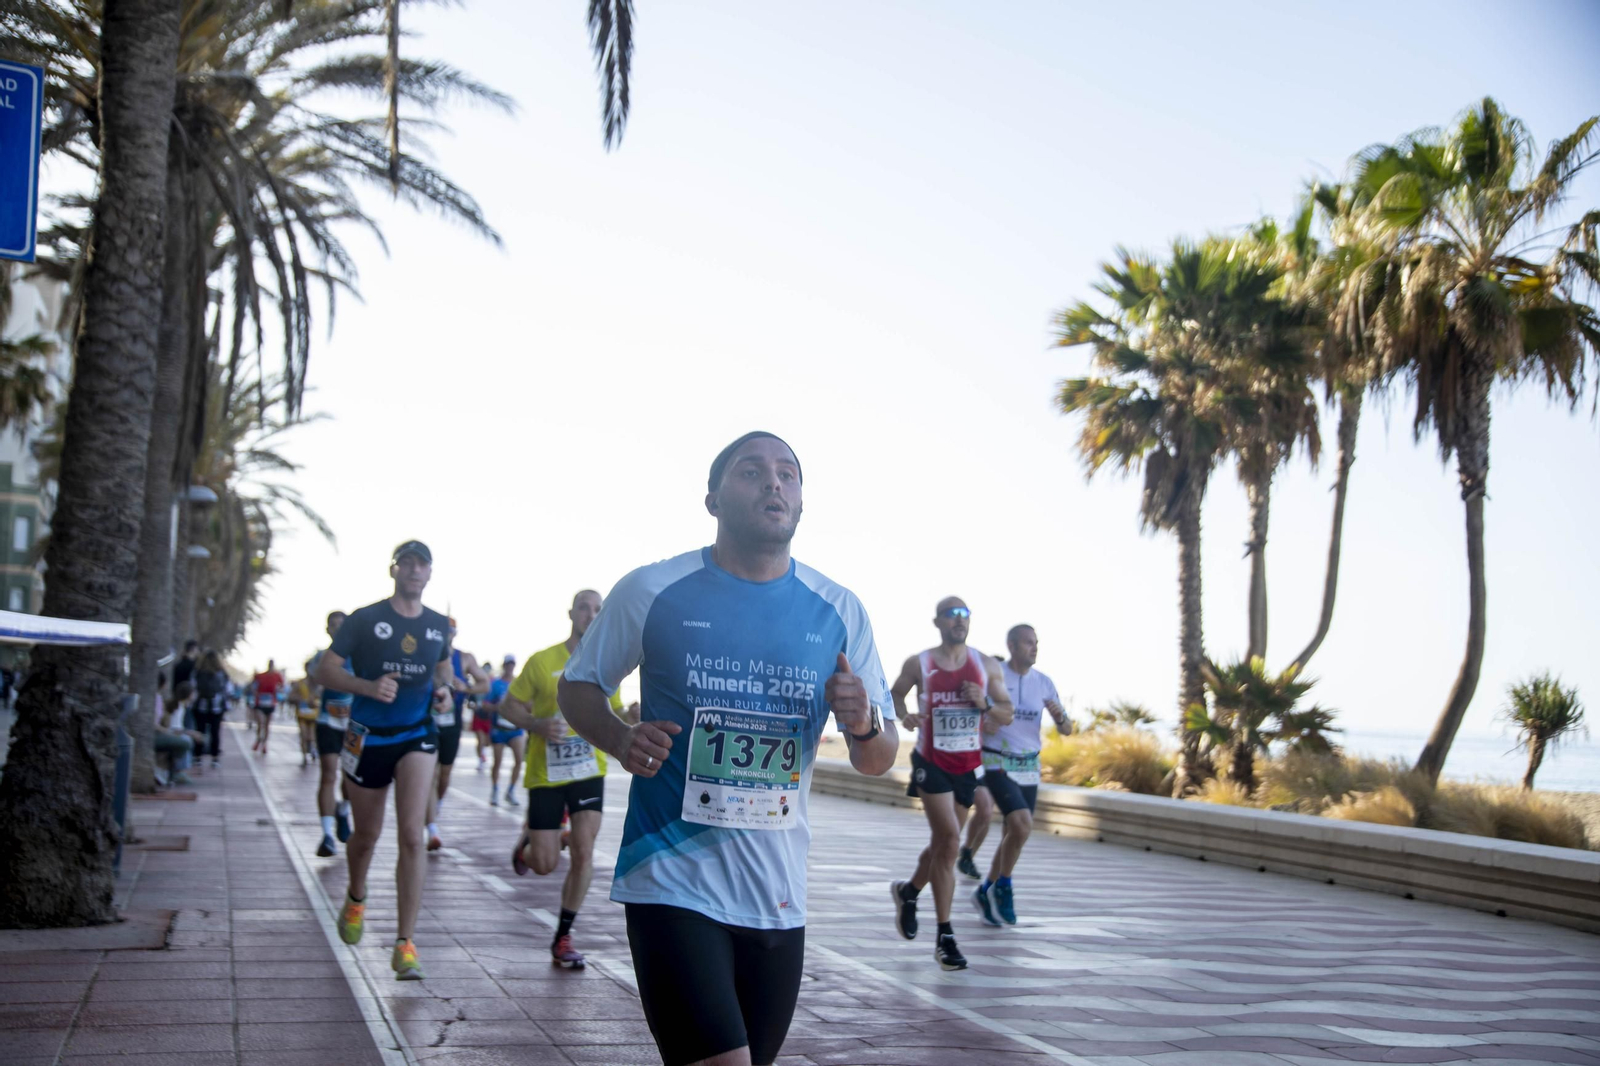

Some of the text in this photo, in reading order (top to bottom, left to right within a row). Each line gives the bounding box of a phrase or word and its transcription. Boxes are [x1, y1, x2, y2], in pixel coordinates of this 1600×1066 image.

[685, 653, 818, 682] Medio Maratón
[686, 669, 816, 700] Almería 2025
[686, 693, 730, 708] RAMÓN
[735, 699, 762, 711] RUIZ
[724, 720, 749, 730] Almería
[750, 723, 767, 731] 2025
[940, 716, 976, 730] 1036
[706, 731, 797, 772] 1379
